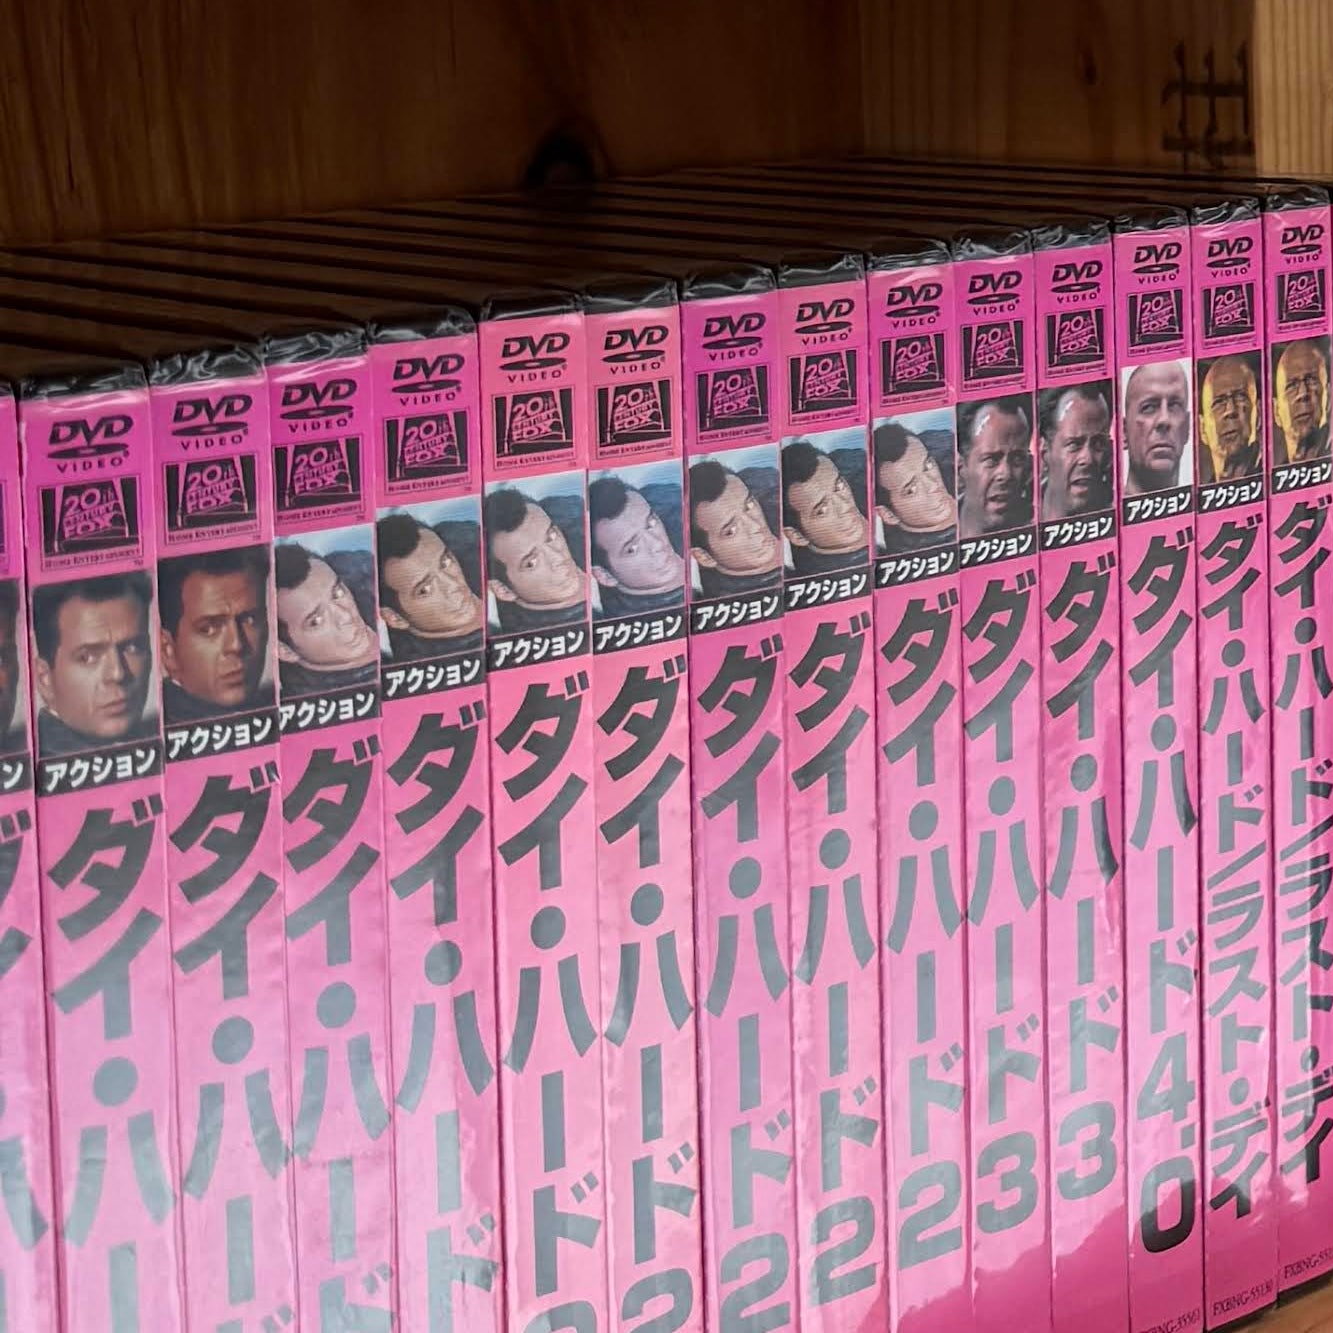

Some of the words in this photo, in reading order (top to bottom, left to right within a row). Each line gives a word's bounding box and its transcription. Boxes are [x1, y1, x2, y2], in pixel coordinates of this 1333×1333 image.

[1281, 224, 1325, 244] DVD
[1134, 242, 1182, 264] DVD
[1208, 236, 1253, 258] DVD
[968, 270, 1023, 294] DVD
[1052, 260, 1103, 283] DVD
[886, 282, 943, 306] DVD
[796, 298, 855, 323] DVD
[1215, 311, 1242, 326] FOX
[703, 312, 766, 338] DVD
[1141, 318, 1170, 333] FOX
[502, 332, 570, 359] DVD
[604, 325, 669, 351] DVD
[1060, 339, 1092, 353] FOX
[392, 353, 465, 381] DVD
[610, 361, 661, 375] VIDEO
[977, 350, 1010, 366] FOX
[507, 369, 562, 384] VIDEO
[896, 365, 930, 381] FOX
[281, 378, 358, 408] DVD
[400, 391, 456, 406] VIDEO
[806, 381, 841, 400] FOX
[172, 394, 253, 424] DVD
[714, 398, 750, 417] FOX
[48, 413, 135, 445] DVD
[288, 418, 348, 433] VIDEO
[512, 423, 553, 443] FOX
[614, 414, 652, 433] FOX
[181, 434, 243, 451] VIDEO
[57, 457, 124, 474] VIDEO
[405, 447, 446, 466] FOX
[295, 474, 337, 495] FOX
[1274, 461, 1332, 491] アクション
[187, 489, 233, 514] FOX
[1127, 491, 1192, 521] アクション
[1201, 480, 1263, 510] アクション
[63, 512, 113, 539] FOX
[1044, 515, 1114, 547] アクション
[960, 532, 1032, 567] アクション
[880, 551, 954, 587] アクション
[788, 573, 867, 609] アクション
[696, 595, 780, 631] アクション
[595, 614, 683, 652] アクション
[493, 628, 585, 667] アクション
[385, 658, 481, 698] アクション
[279, 691, 375, 733] アクション
[167, 716, 272, 759] アクション
[45, 746, 156, 792] アクション
